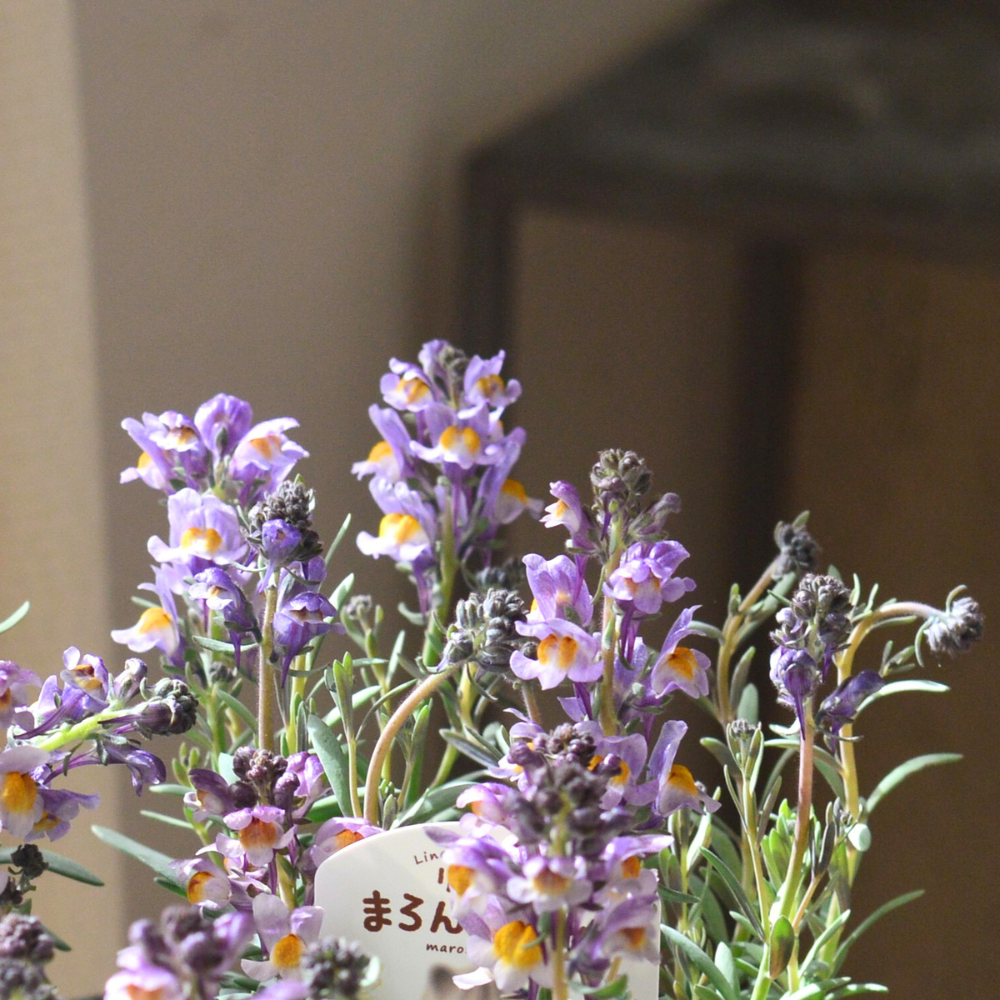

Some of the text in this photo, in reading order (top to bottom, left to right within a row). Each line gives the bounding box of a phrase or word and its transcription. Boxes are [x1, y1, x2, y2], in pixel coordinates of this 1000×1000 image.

[362, 890, 463, 934] まろん
[426, 943, 468, 955] maro
